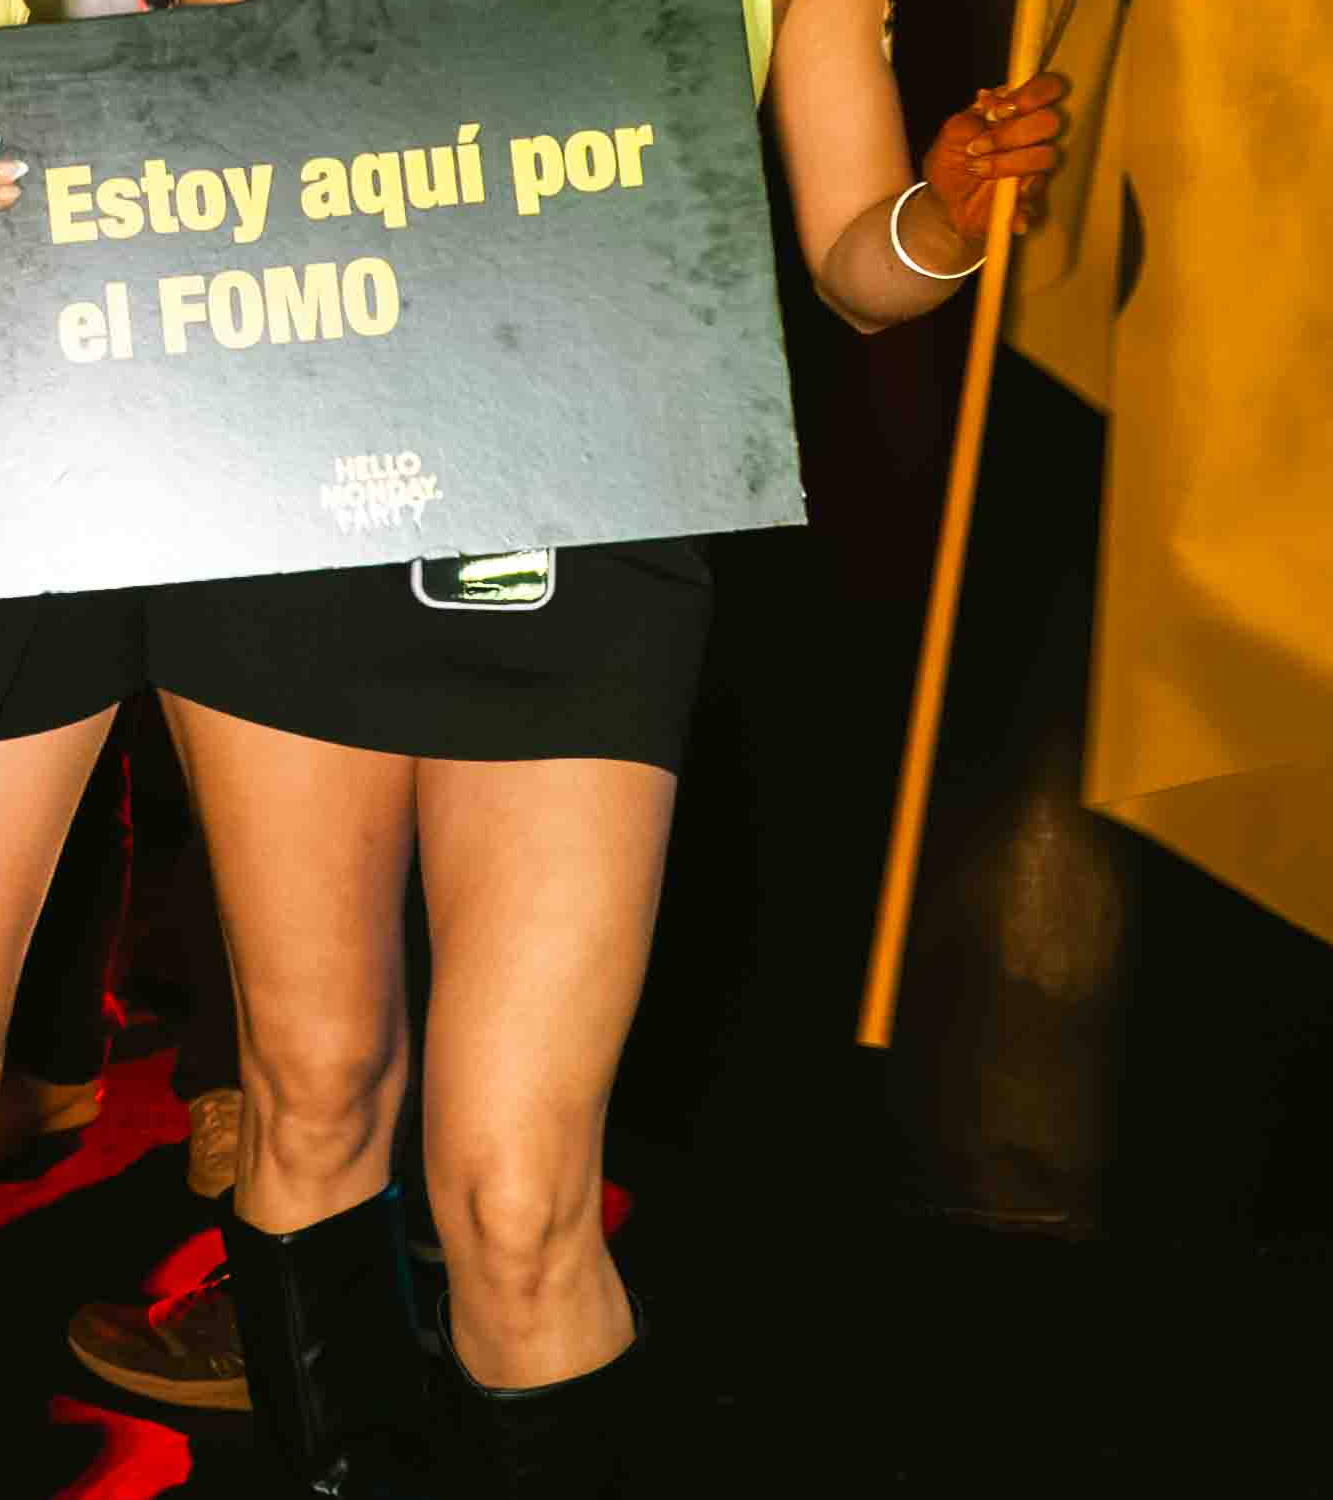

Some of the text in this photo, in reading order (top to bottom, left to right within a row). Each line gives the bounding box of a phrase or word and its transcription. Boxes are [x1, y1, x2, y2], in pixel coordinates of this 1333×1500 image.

[44, 123, 654, 244] Estoy aquí por
[57, 256, 400, 364] el FOMO
[334, 451, 422, 481] HELLO
